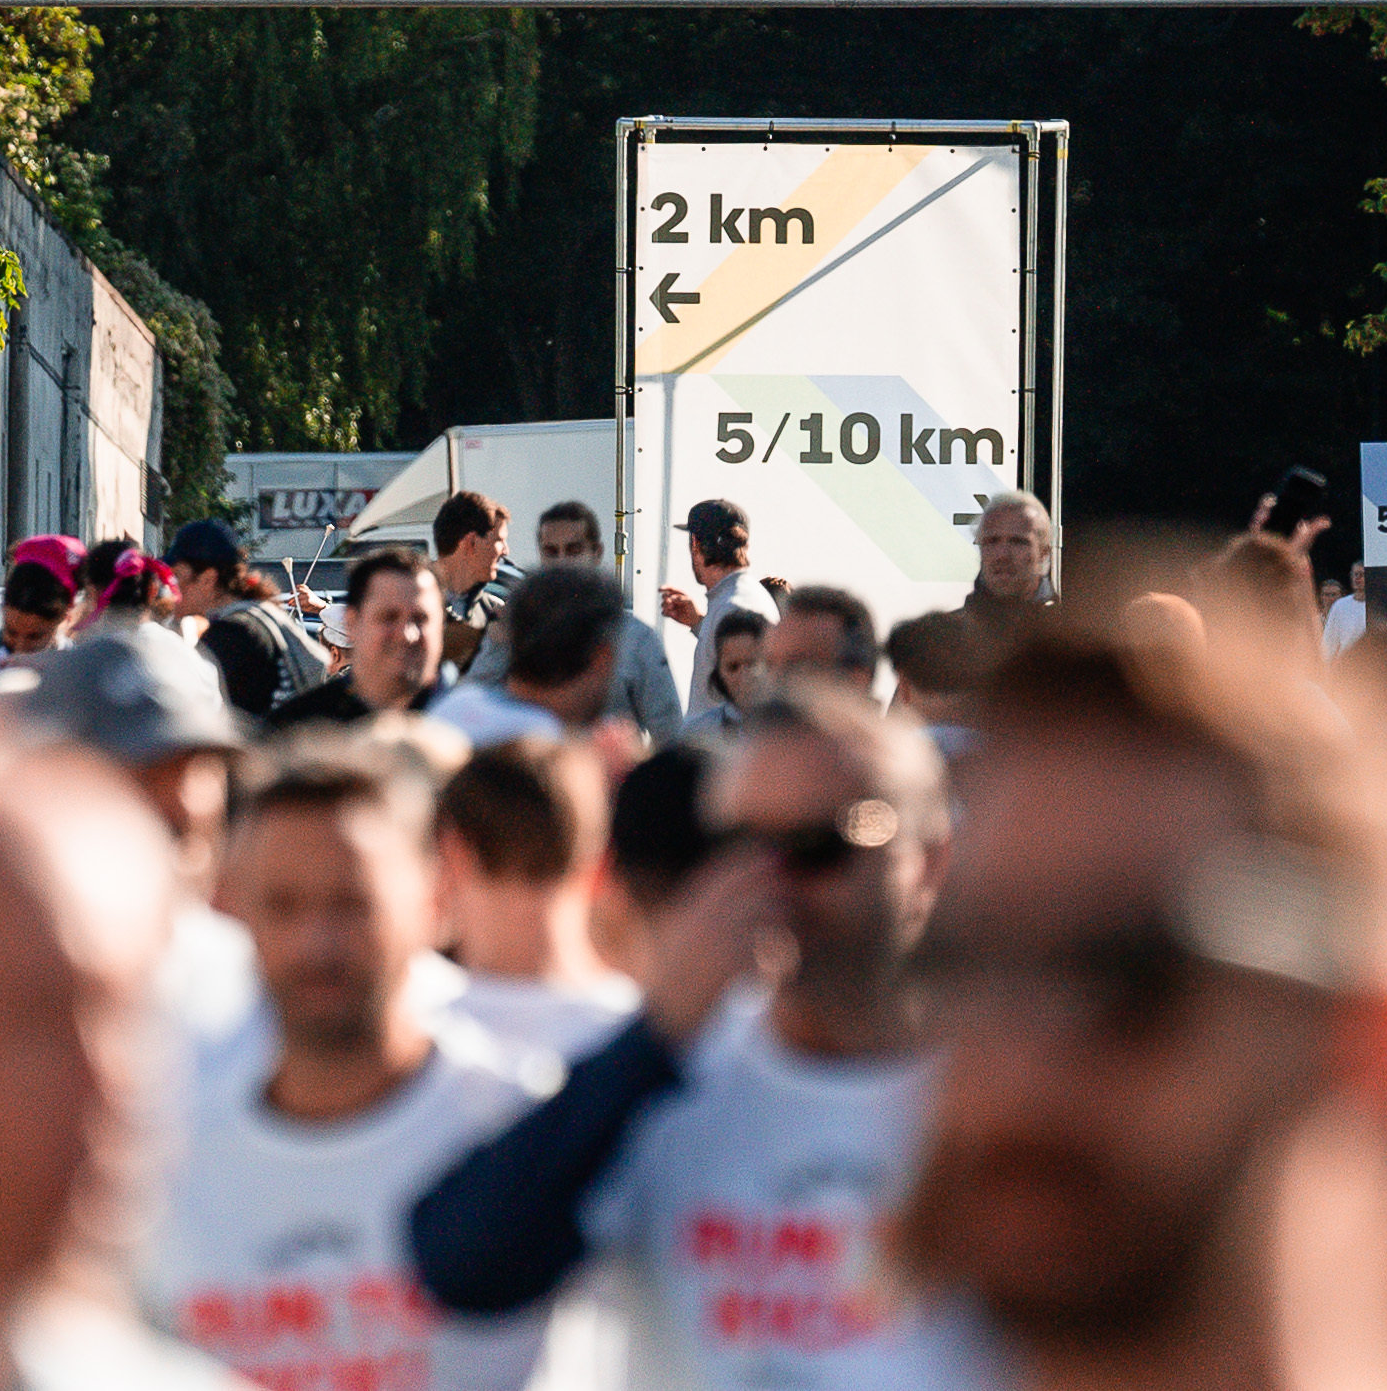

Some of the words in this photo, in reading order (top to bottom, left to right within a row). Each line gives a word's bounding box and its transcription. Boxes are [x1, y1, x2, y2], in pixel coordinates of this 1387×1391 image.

[651, 192, 689, 244] 2
[709, 193, 814, 244] km
[715, 412, 880, 465] 5/10
[900, 413, 1004, 465] km
